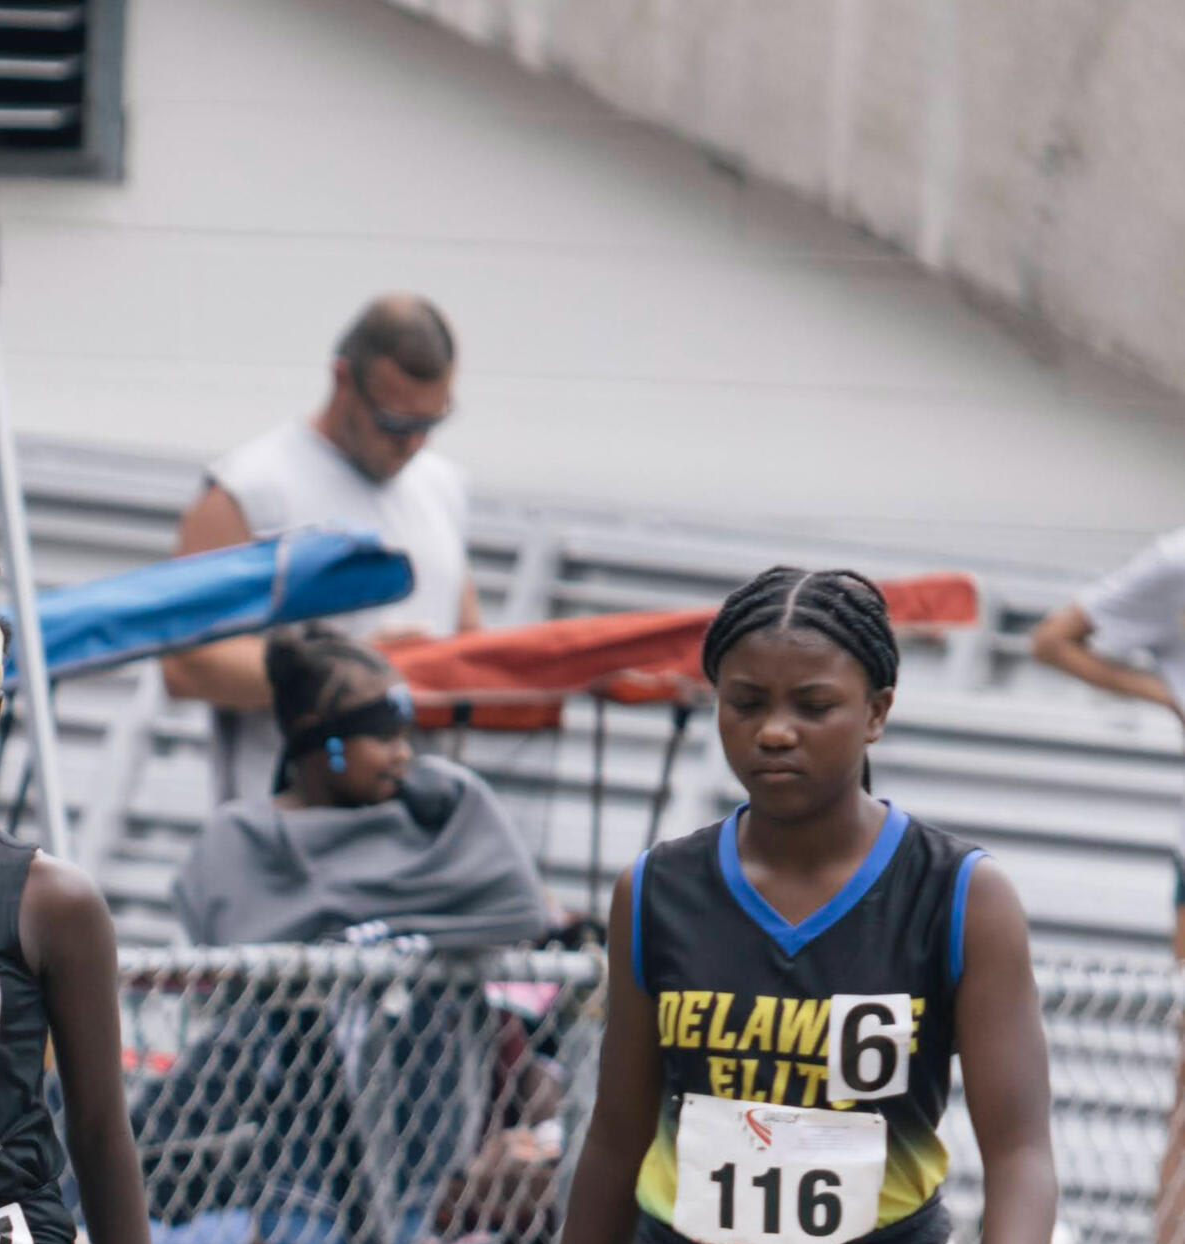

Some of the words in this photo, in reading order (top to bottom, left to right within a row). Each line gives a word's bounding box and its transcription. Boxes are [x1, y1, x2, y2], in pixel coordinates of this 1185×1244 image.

[658, 990, 926, 1057] DELAWE
[840, 1001, 899, 1093] 6
[707, 1056, 857, 1111] ELIT
[710, 1162, 843, 1238] 116
